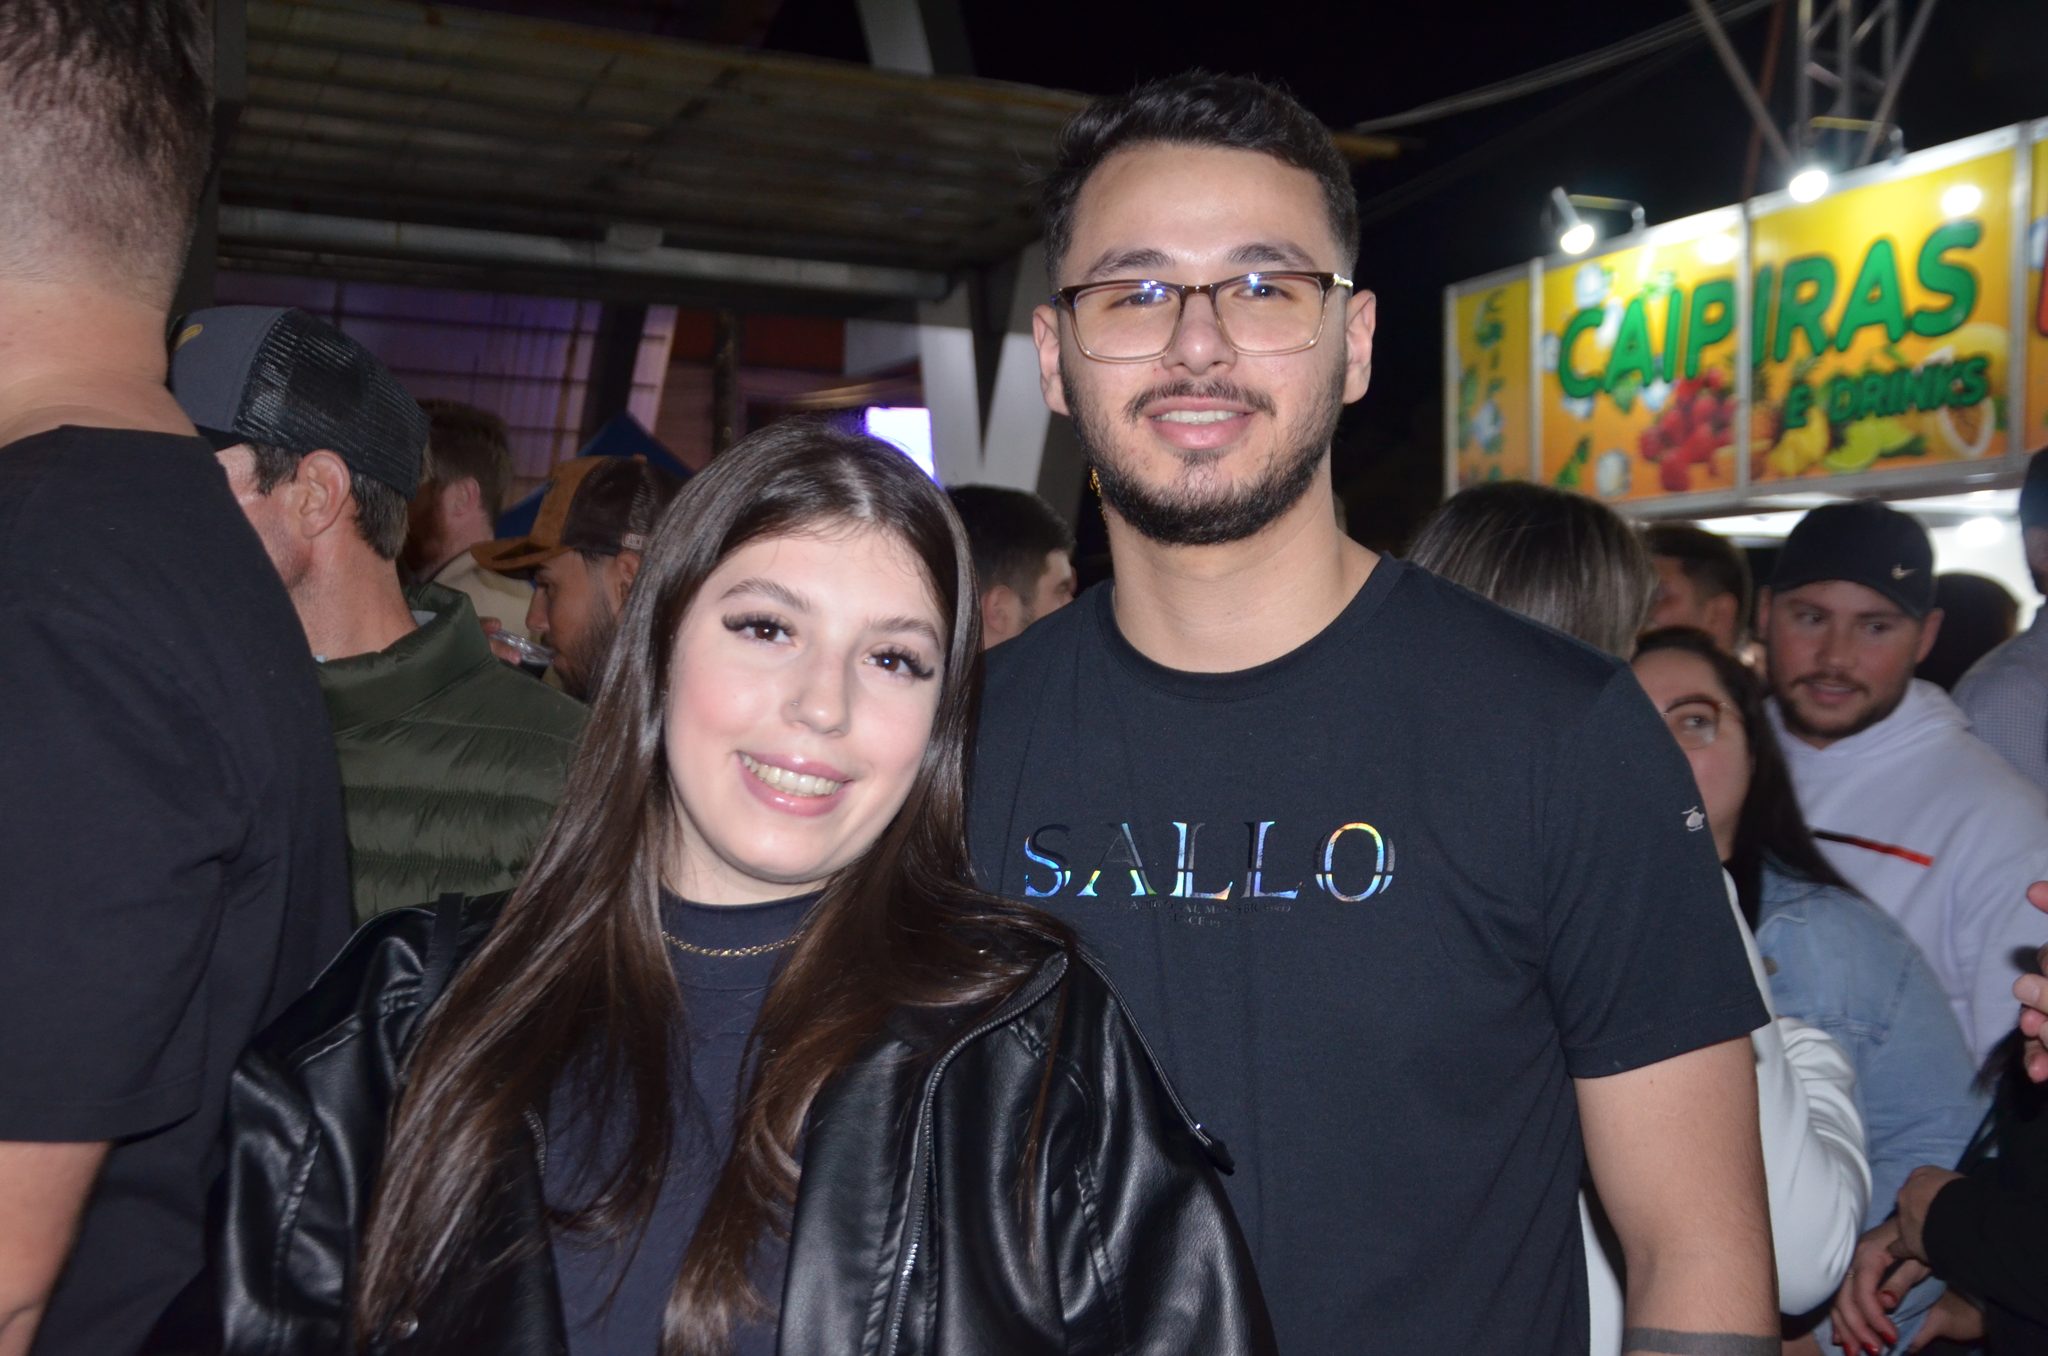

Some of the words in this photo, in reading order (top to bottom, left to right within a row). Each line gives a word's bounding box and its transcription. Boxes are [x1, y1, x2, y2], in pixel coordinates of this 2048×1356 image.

[1558, 219, 1981, 398] CAIPIRAS
[1826, 354, 1991, 424] DRINKS
[1024, 820, 1397, 902] SALLO
